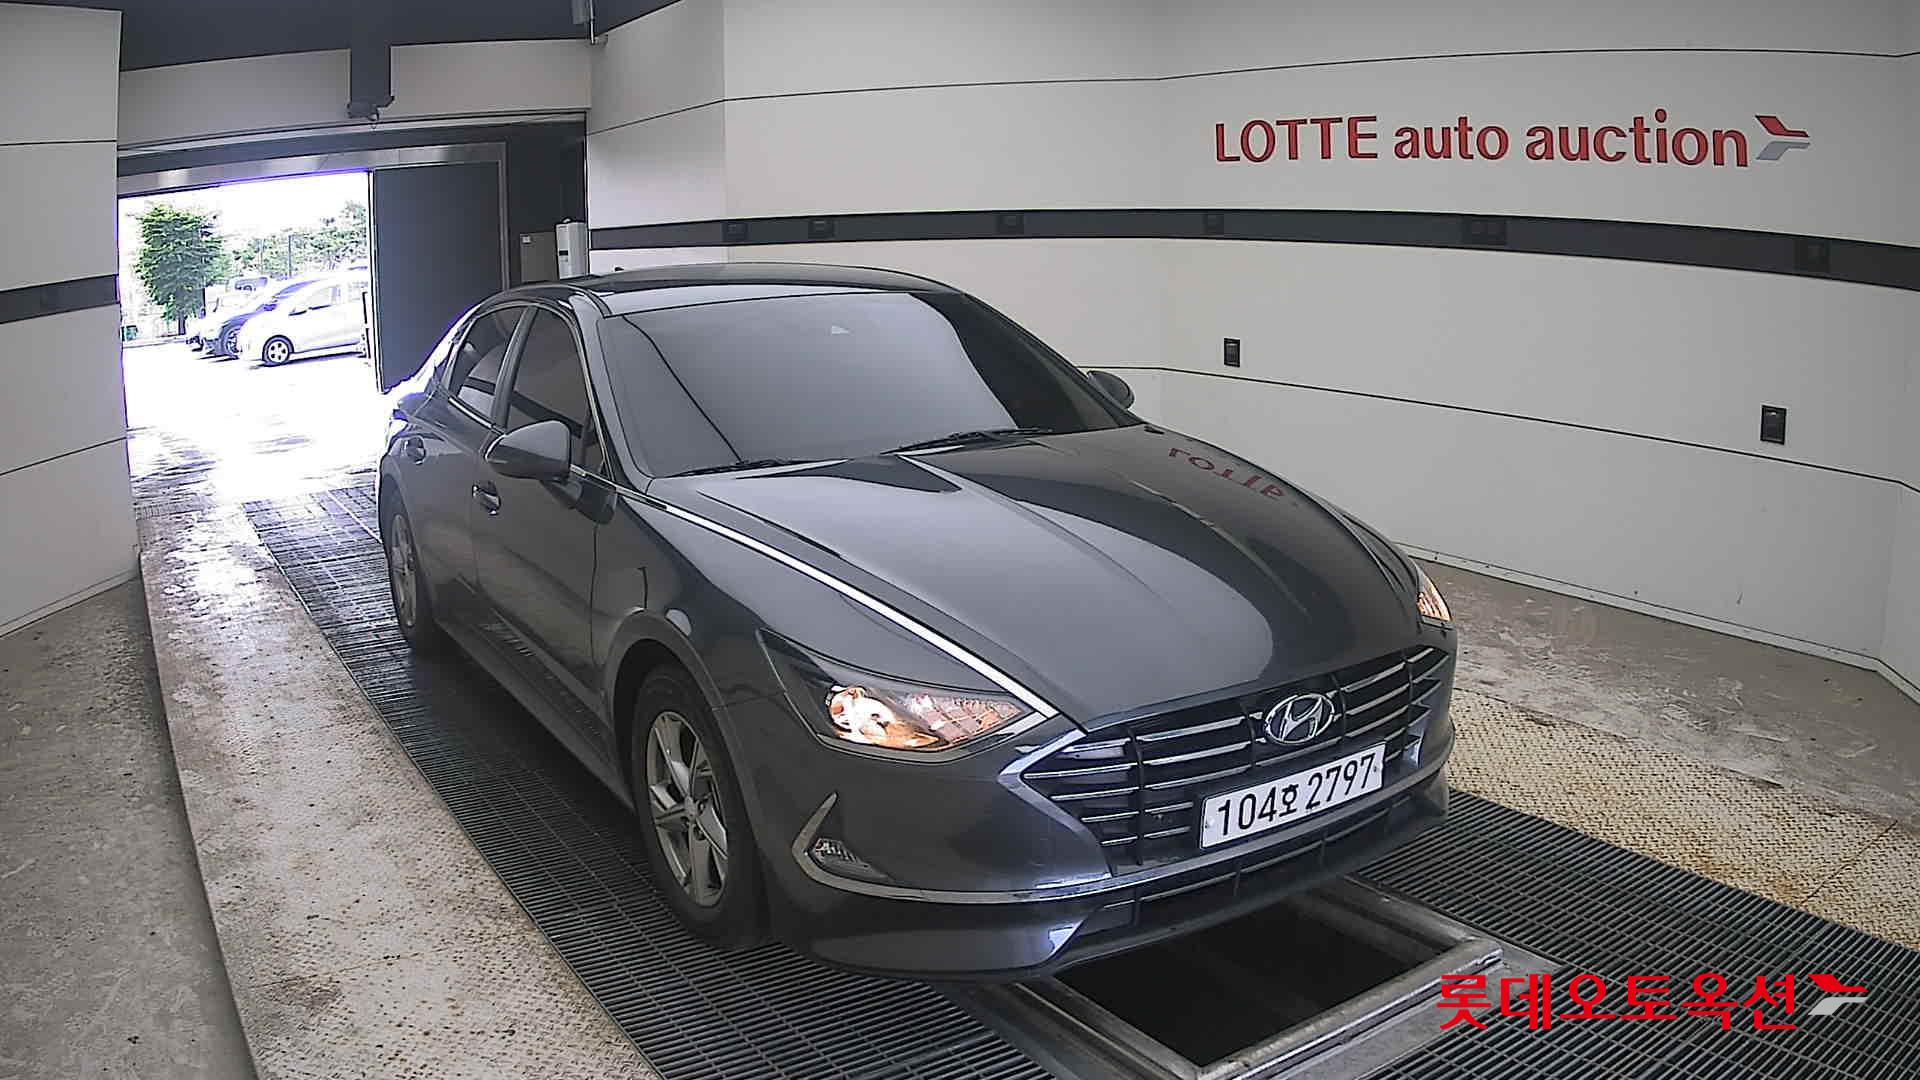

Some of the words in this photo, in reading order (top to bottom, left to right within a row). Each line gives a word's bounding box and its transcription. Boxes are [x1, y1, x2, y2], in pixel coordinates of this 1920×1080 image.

[1214, 115, 1378, 163] LOTTE
[1393, 115, 1510, 162] auto
[1524, 108, 1749, 168] auction
[1305, 753, 1376, 810] 2797
